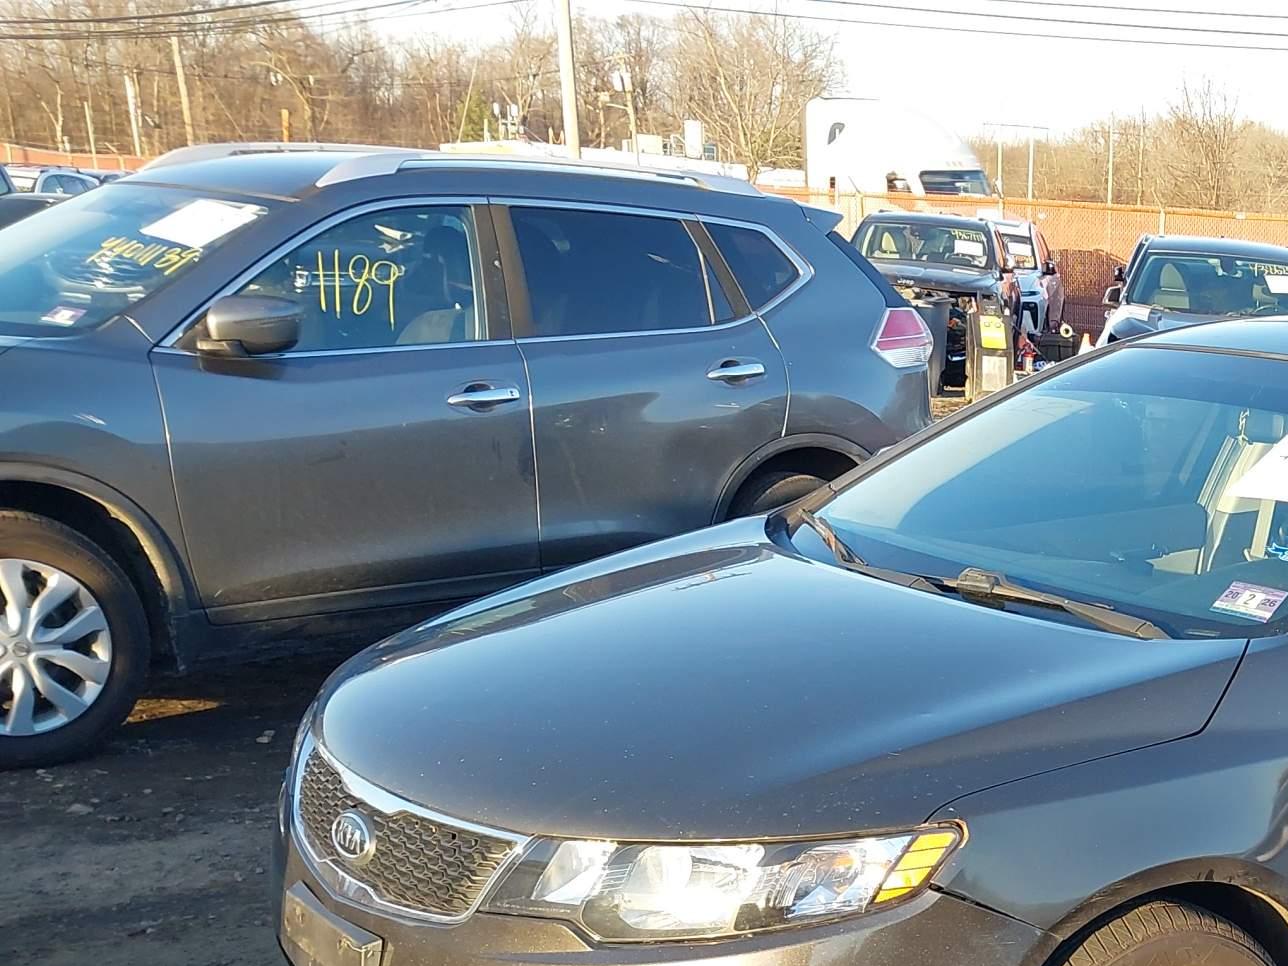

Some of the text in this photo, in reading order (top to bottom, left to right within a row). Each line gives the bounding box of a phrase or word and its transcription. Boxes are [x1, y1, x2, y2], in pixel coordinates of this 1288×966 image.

[1225, 591, 1277, 607] 20 2 26
[337, 820, 361, 855] KIA
